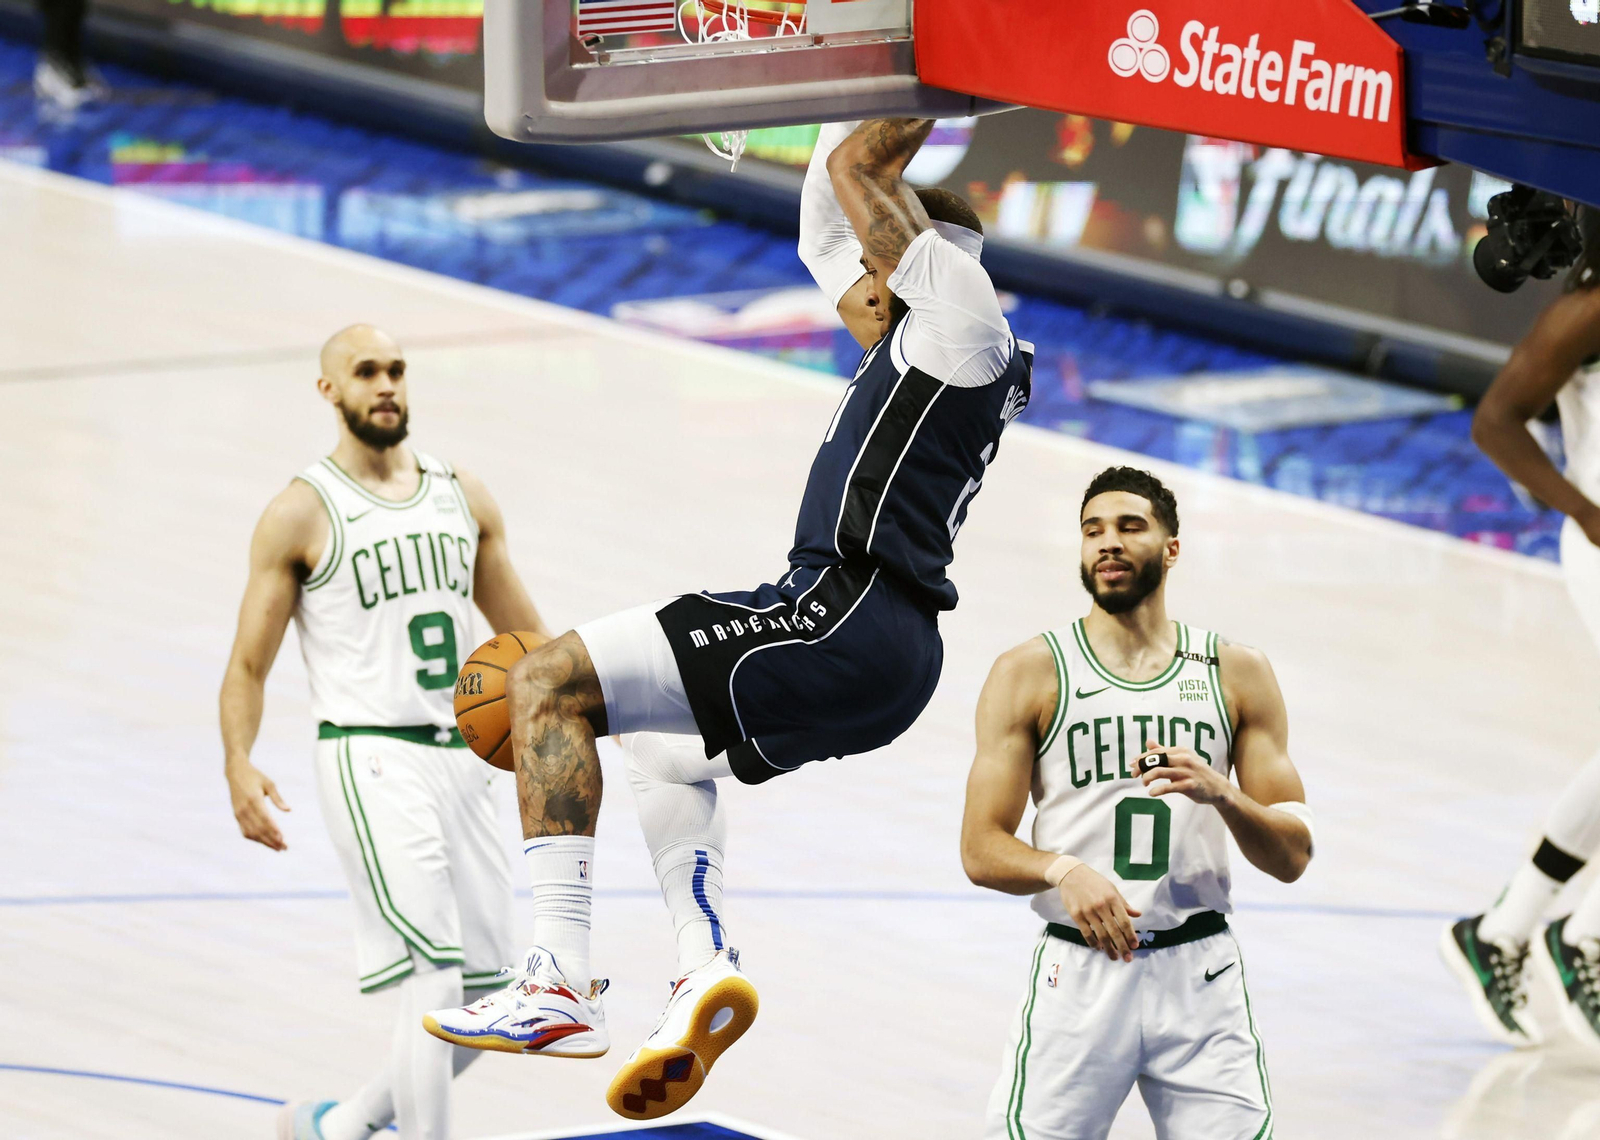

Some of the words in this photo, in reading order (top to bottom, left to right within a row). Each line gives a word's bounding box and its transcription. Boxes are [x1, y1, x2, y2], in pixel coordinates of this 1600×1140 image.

[352, 532, 471, 610] CELTICS
[407, 610, 459, 691] 9
[1177, 679, 1208, 691] VISTA
[1179, 692, 1209, 702] PRINT
[1113, 796, 1172, 881] 0
